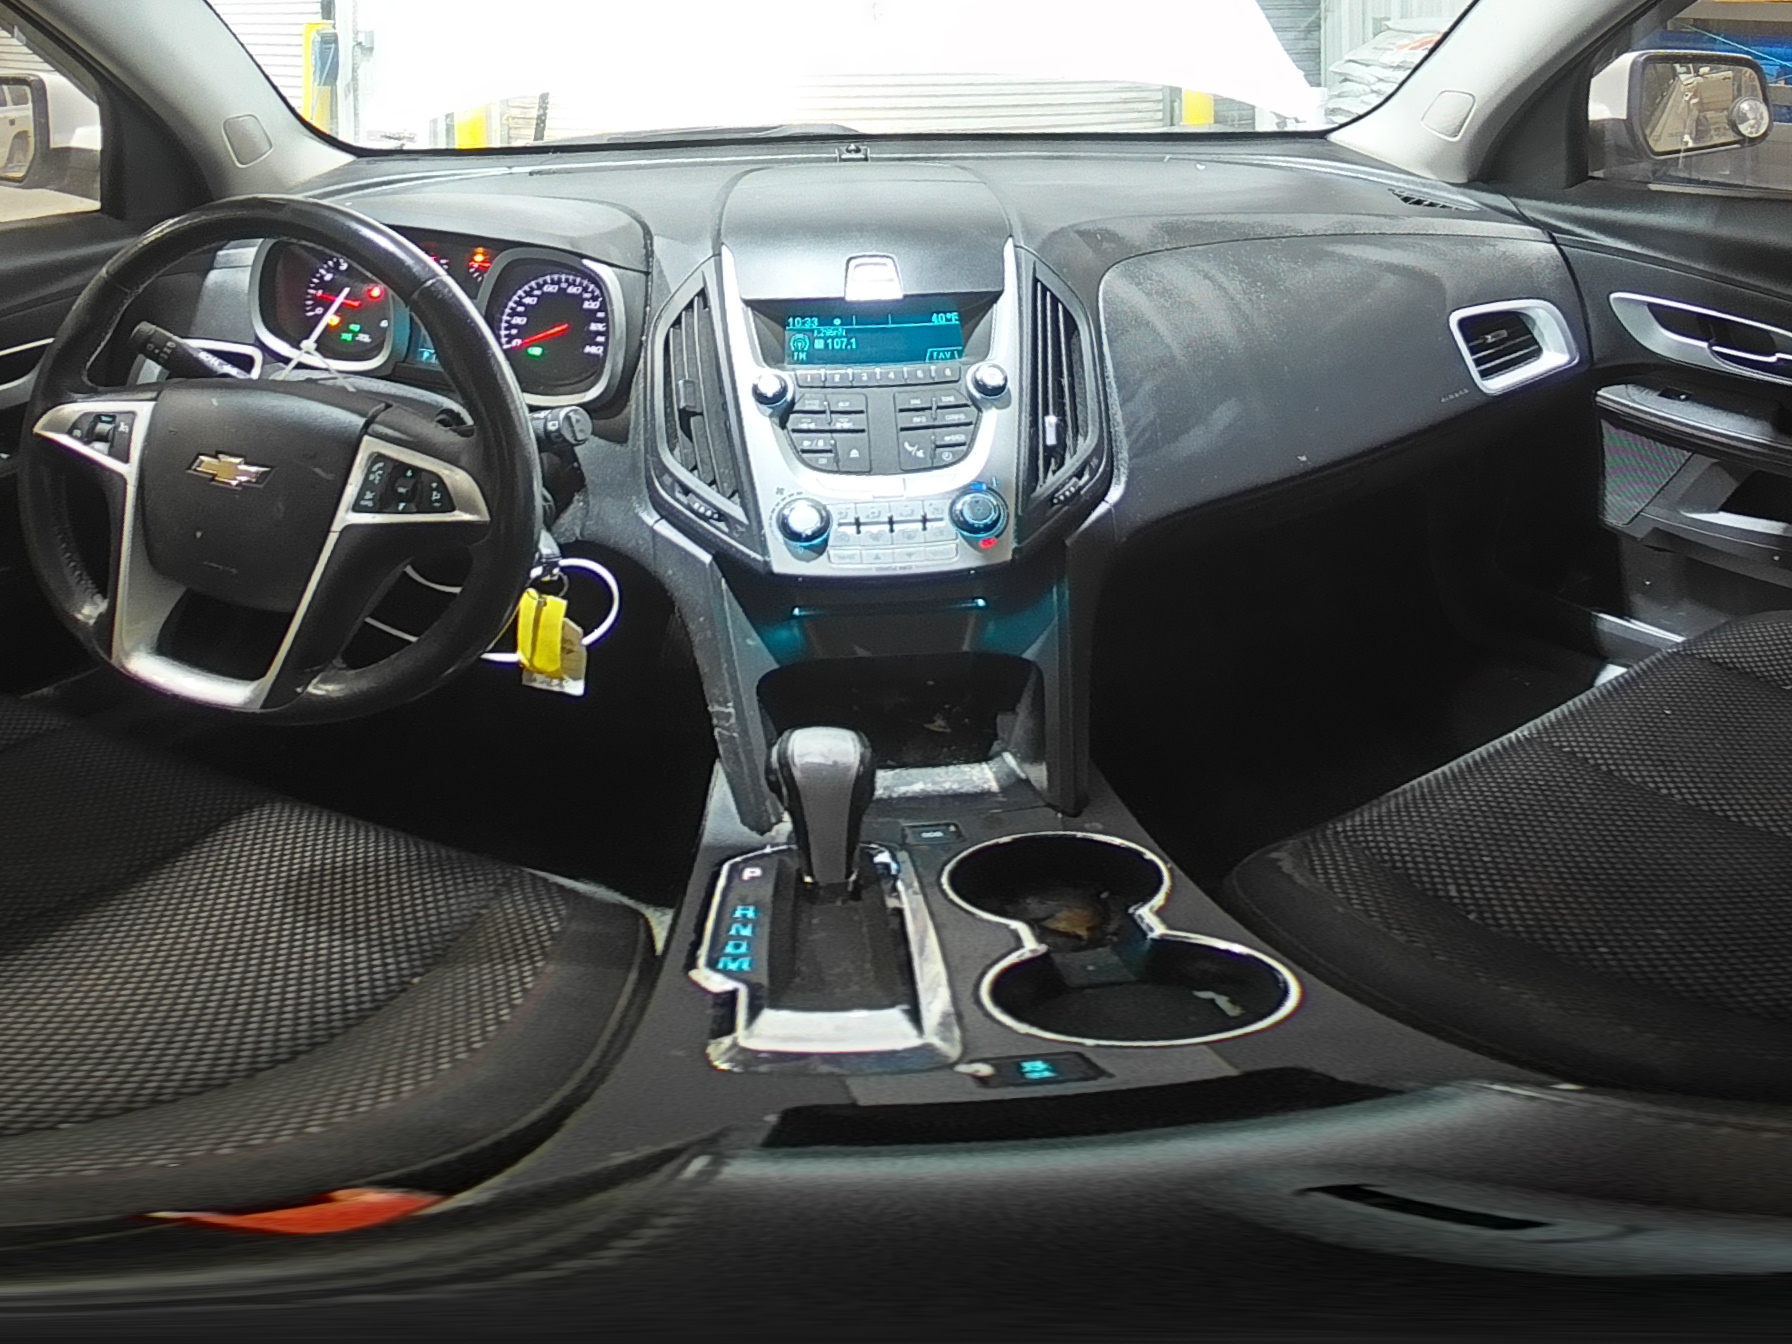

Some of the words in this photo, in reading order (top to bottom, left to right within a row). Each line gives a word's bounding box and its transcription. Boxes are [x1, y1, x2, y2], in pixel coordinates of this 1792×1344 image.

[787, 317, 819, 328] 10:33
[826, 337, 857, 350] 107.1
[742, 867, 762, 881] P
[727, 923, 754, 937] N
[716, 956, 753, 972] M
